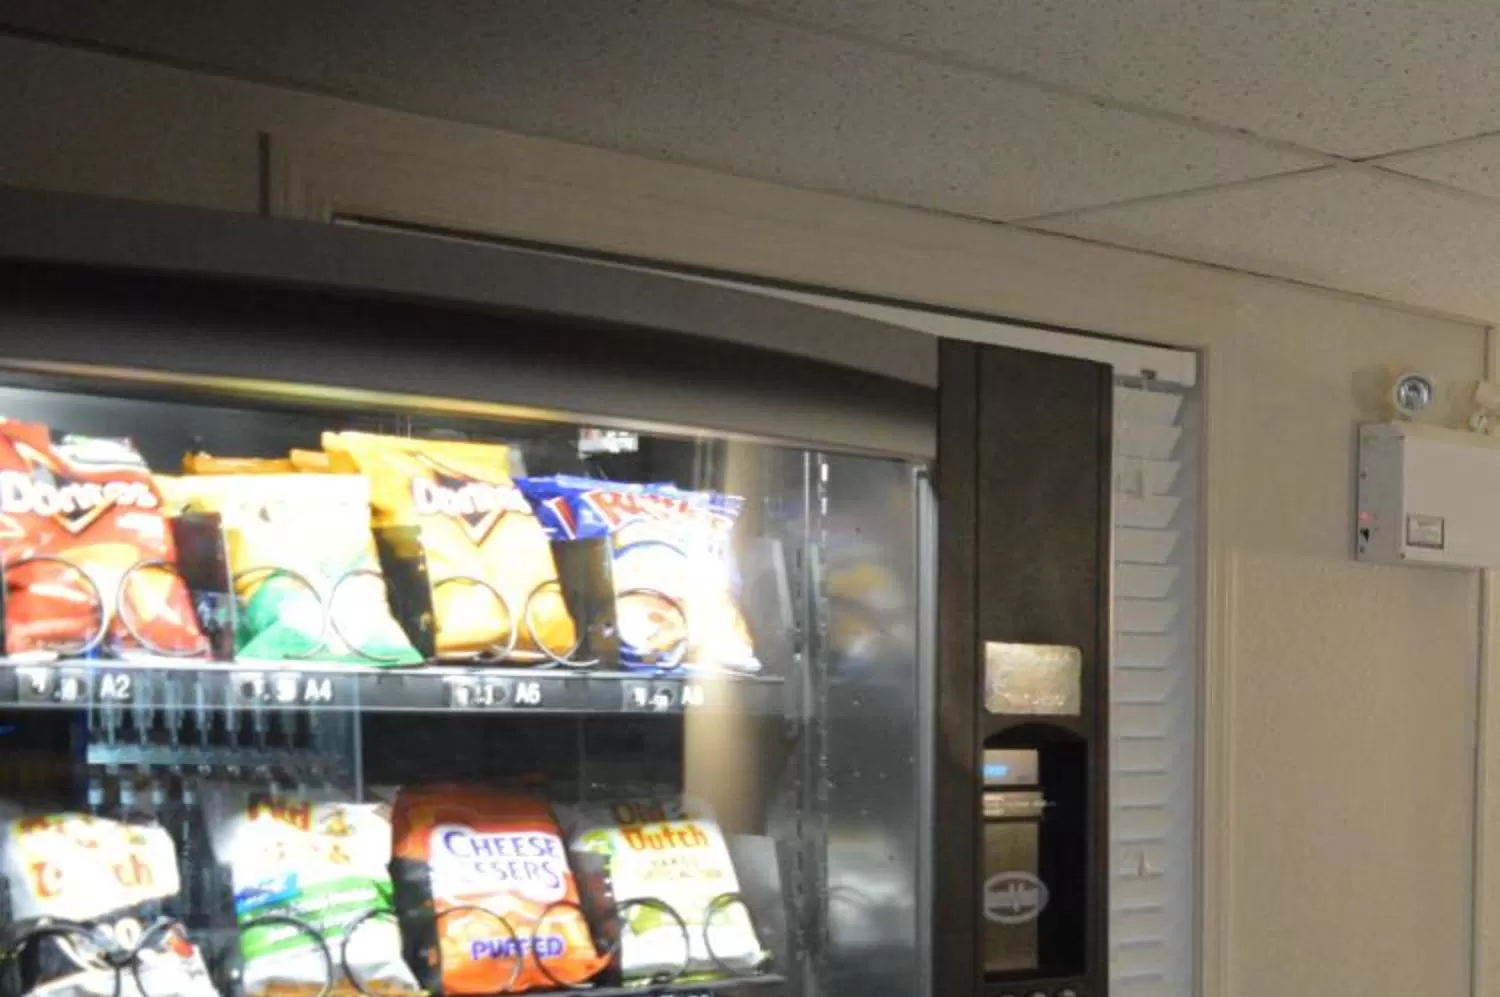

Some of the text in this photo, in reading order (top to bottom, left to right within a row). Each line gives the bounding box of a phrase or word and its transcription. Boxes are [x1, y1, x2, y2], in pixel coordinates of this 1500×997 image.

[100, 673, 130, 698] A2
[304, 676, 331, 701] A4
[442, 830, 561, 859] CHEESE
[621, 821, 709, 851] Dutch
[470, 935, 564, 960] PUFFED
